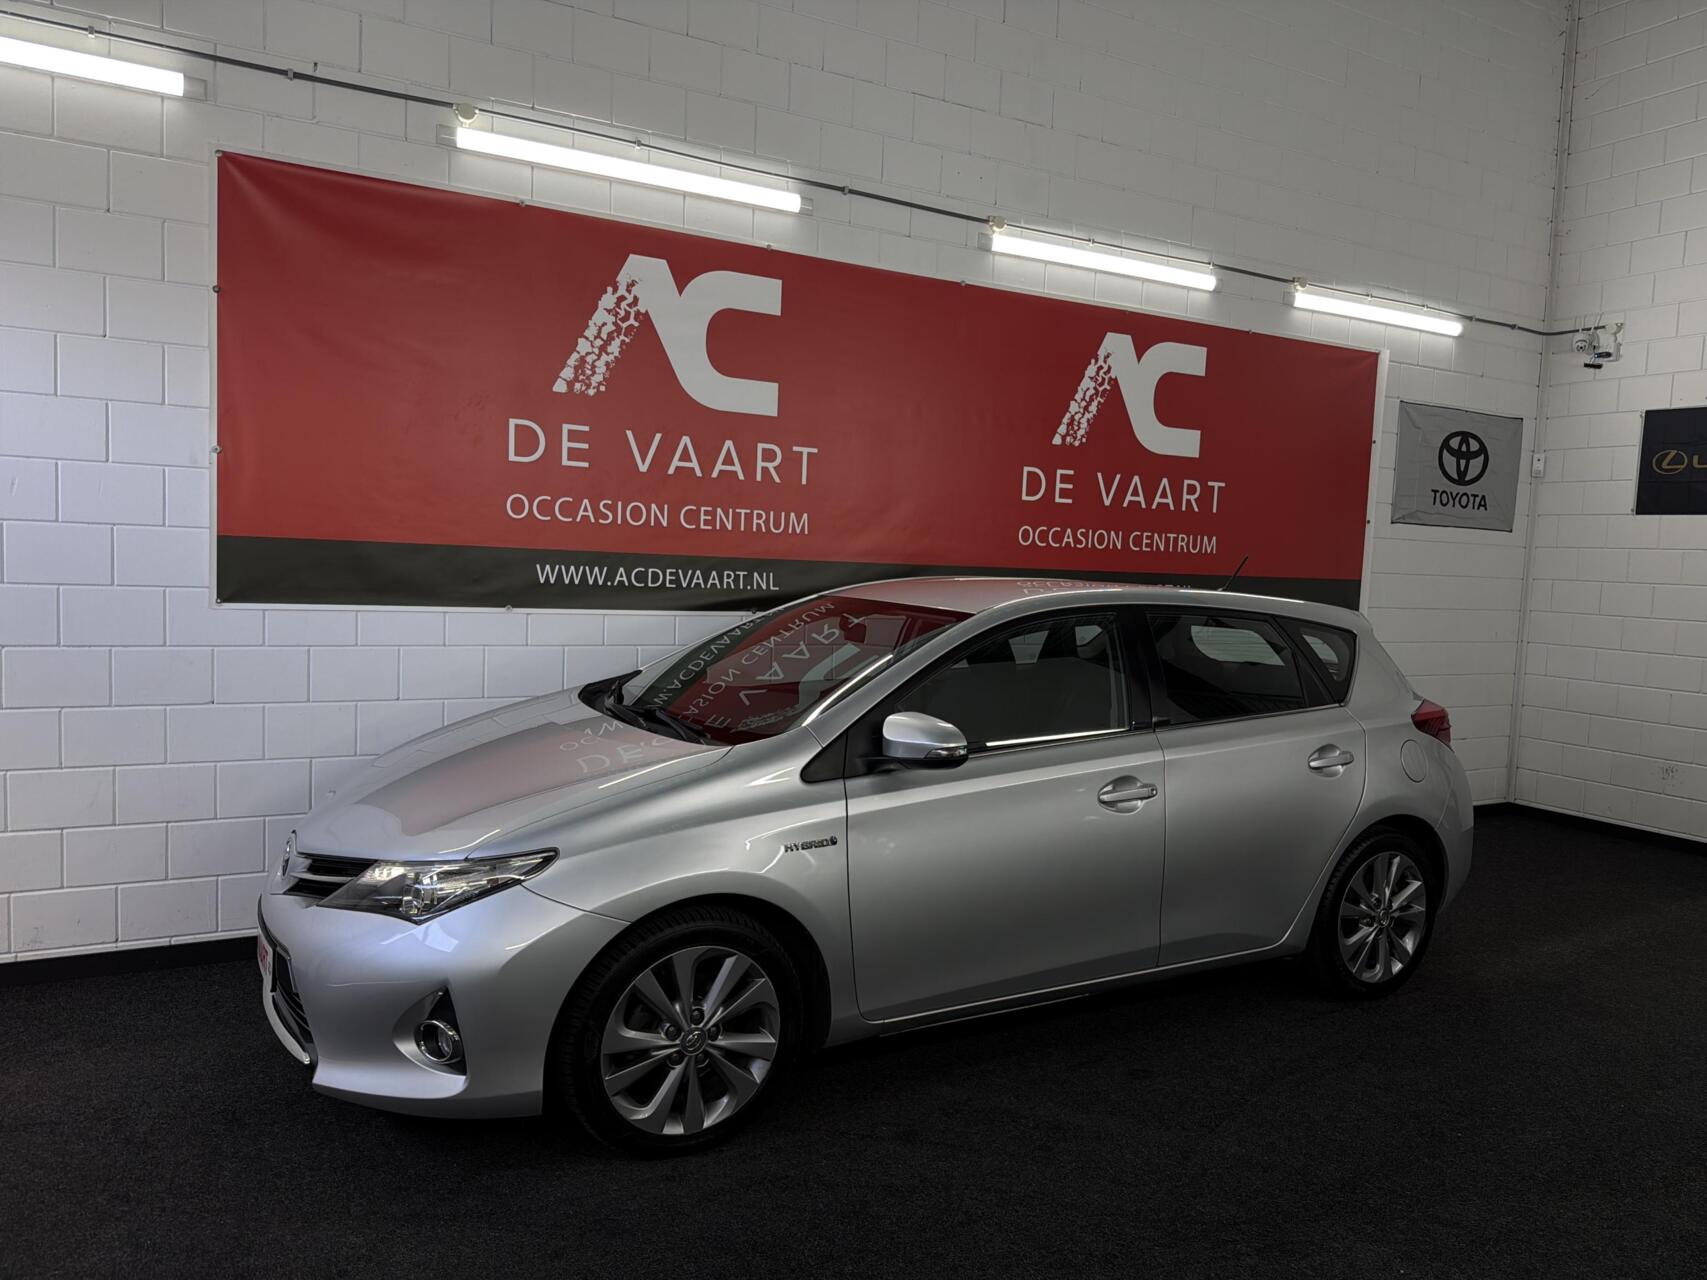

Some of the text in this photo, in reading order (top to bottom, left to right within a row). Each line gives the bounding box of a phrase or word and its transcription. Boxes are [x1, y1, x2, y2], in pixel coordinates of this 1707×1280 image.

[552, 253, 783, 417] AC
[1052, 332, 1208, 458] AC
[508, 418, 818, 485] DE VAART
[1021, 466, 1226, 513] DE VAART
[1431, 489, 1488, 511] TOYOTA
[506, 493, 808, 534] OCCASION CENTRUM
[1018, 525, 1216, 553] OCCASION CENTRUM
[536, 564, 780, 590] WWW.ACDEVAART.NL
